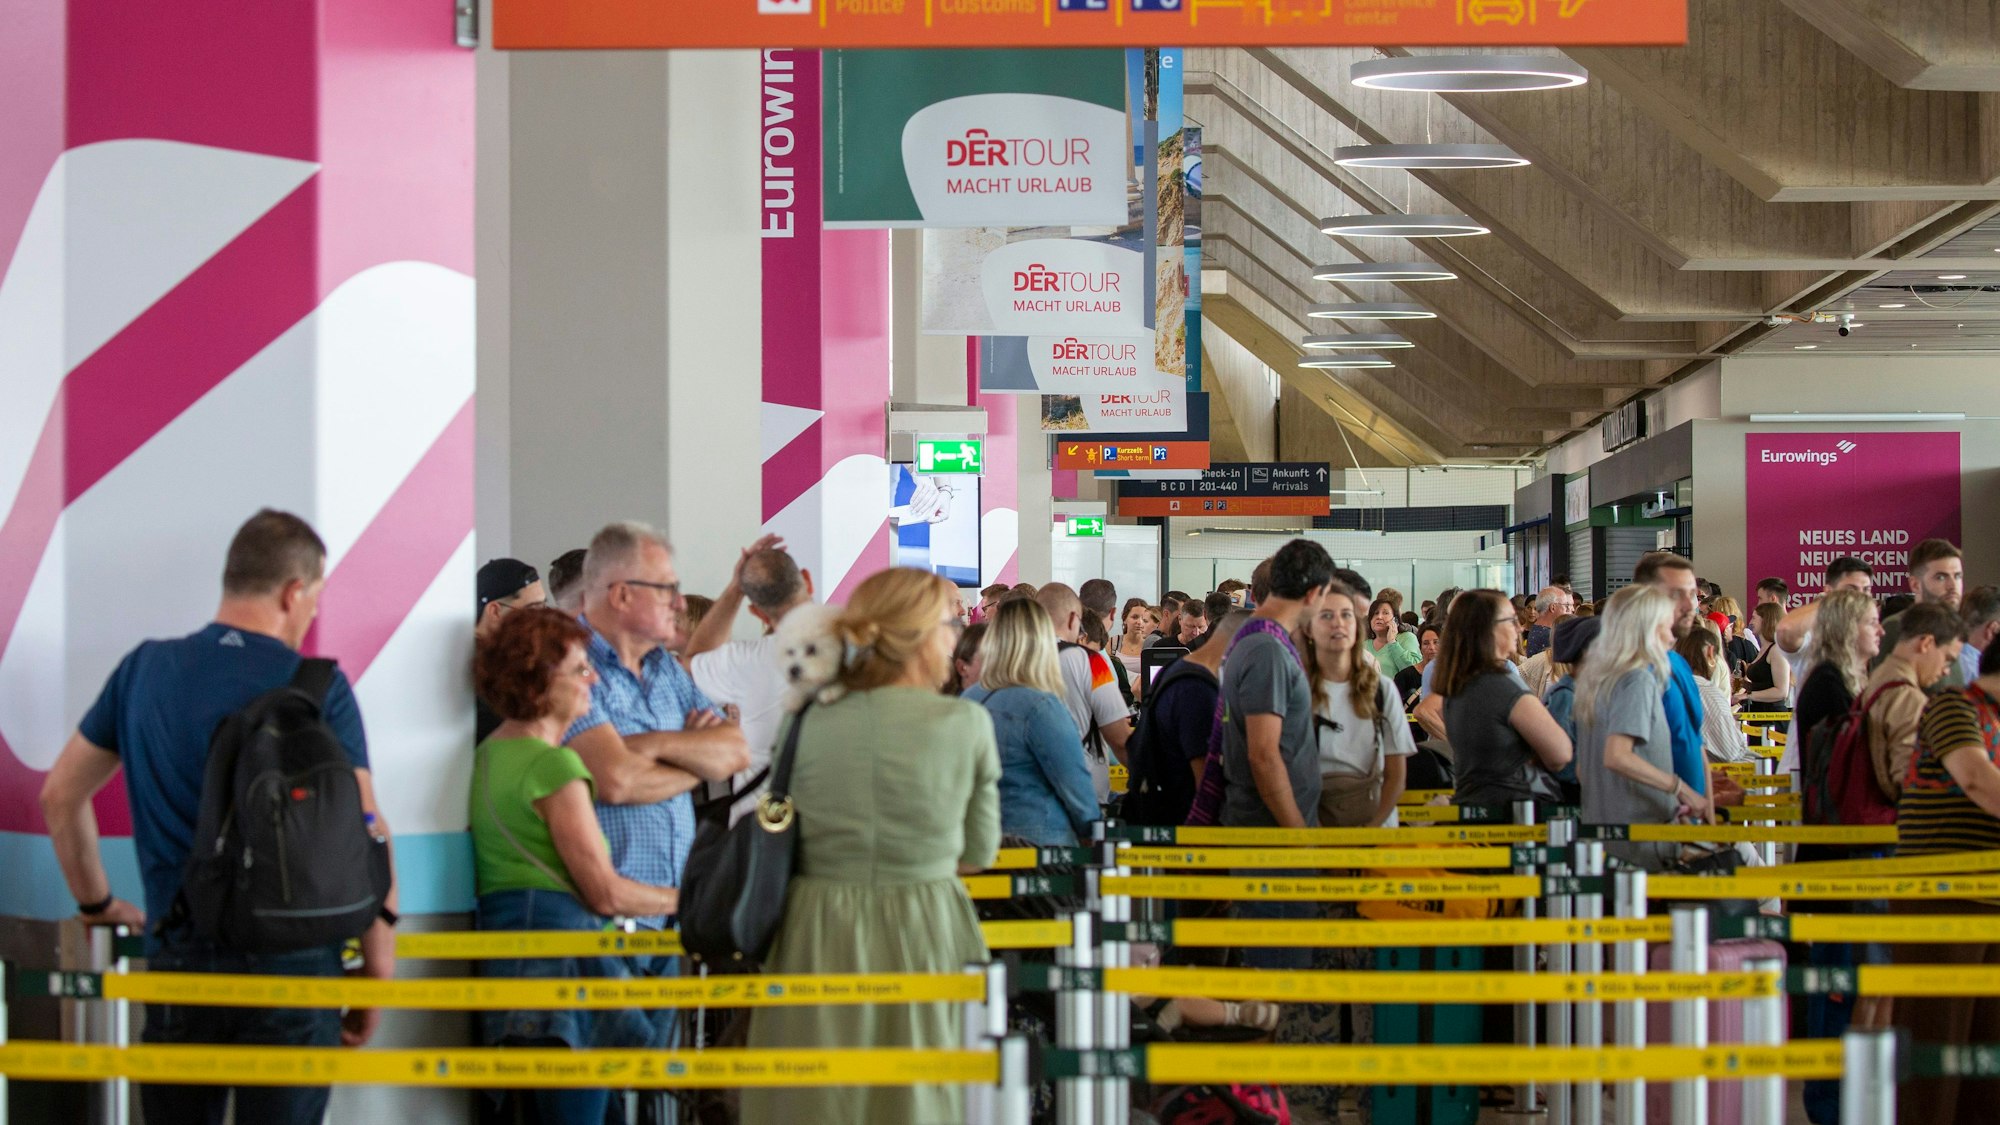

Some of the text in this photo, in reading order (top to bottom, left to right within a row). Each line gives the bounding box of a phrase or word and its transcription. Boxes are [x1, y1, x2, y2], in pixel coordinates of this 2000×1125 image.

[1159, 55, 1173, 68] e
[947, 137, 1090, 166] DERTOUR
[947, 177, 1092, 194] MACHT URLAUB
[1013, 271, 1120, 293] DERTOUR
[1013, 300, 1121, 313] MACHT URLAUB
[1053, 343, 1136, 361] DERTOUR
[1052, 366, 1137, 376] MACHT URLAUB
[1101, 389, 1171, 404] DERTOUR
[1101, 408, 1171, 417] MACHT URLAUB
[1761, 449, 1837, 465] Eurowings
[1272, 469, 1309, 478] Ankunft
[1161, 482, 1186, 491] B C D
[1199, 482, 1237, 491] 201-440
[1272, 482, 1308, 491] Arrivals
[1800, 530, 1909, 545] NEUES LAND
